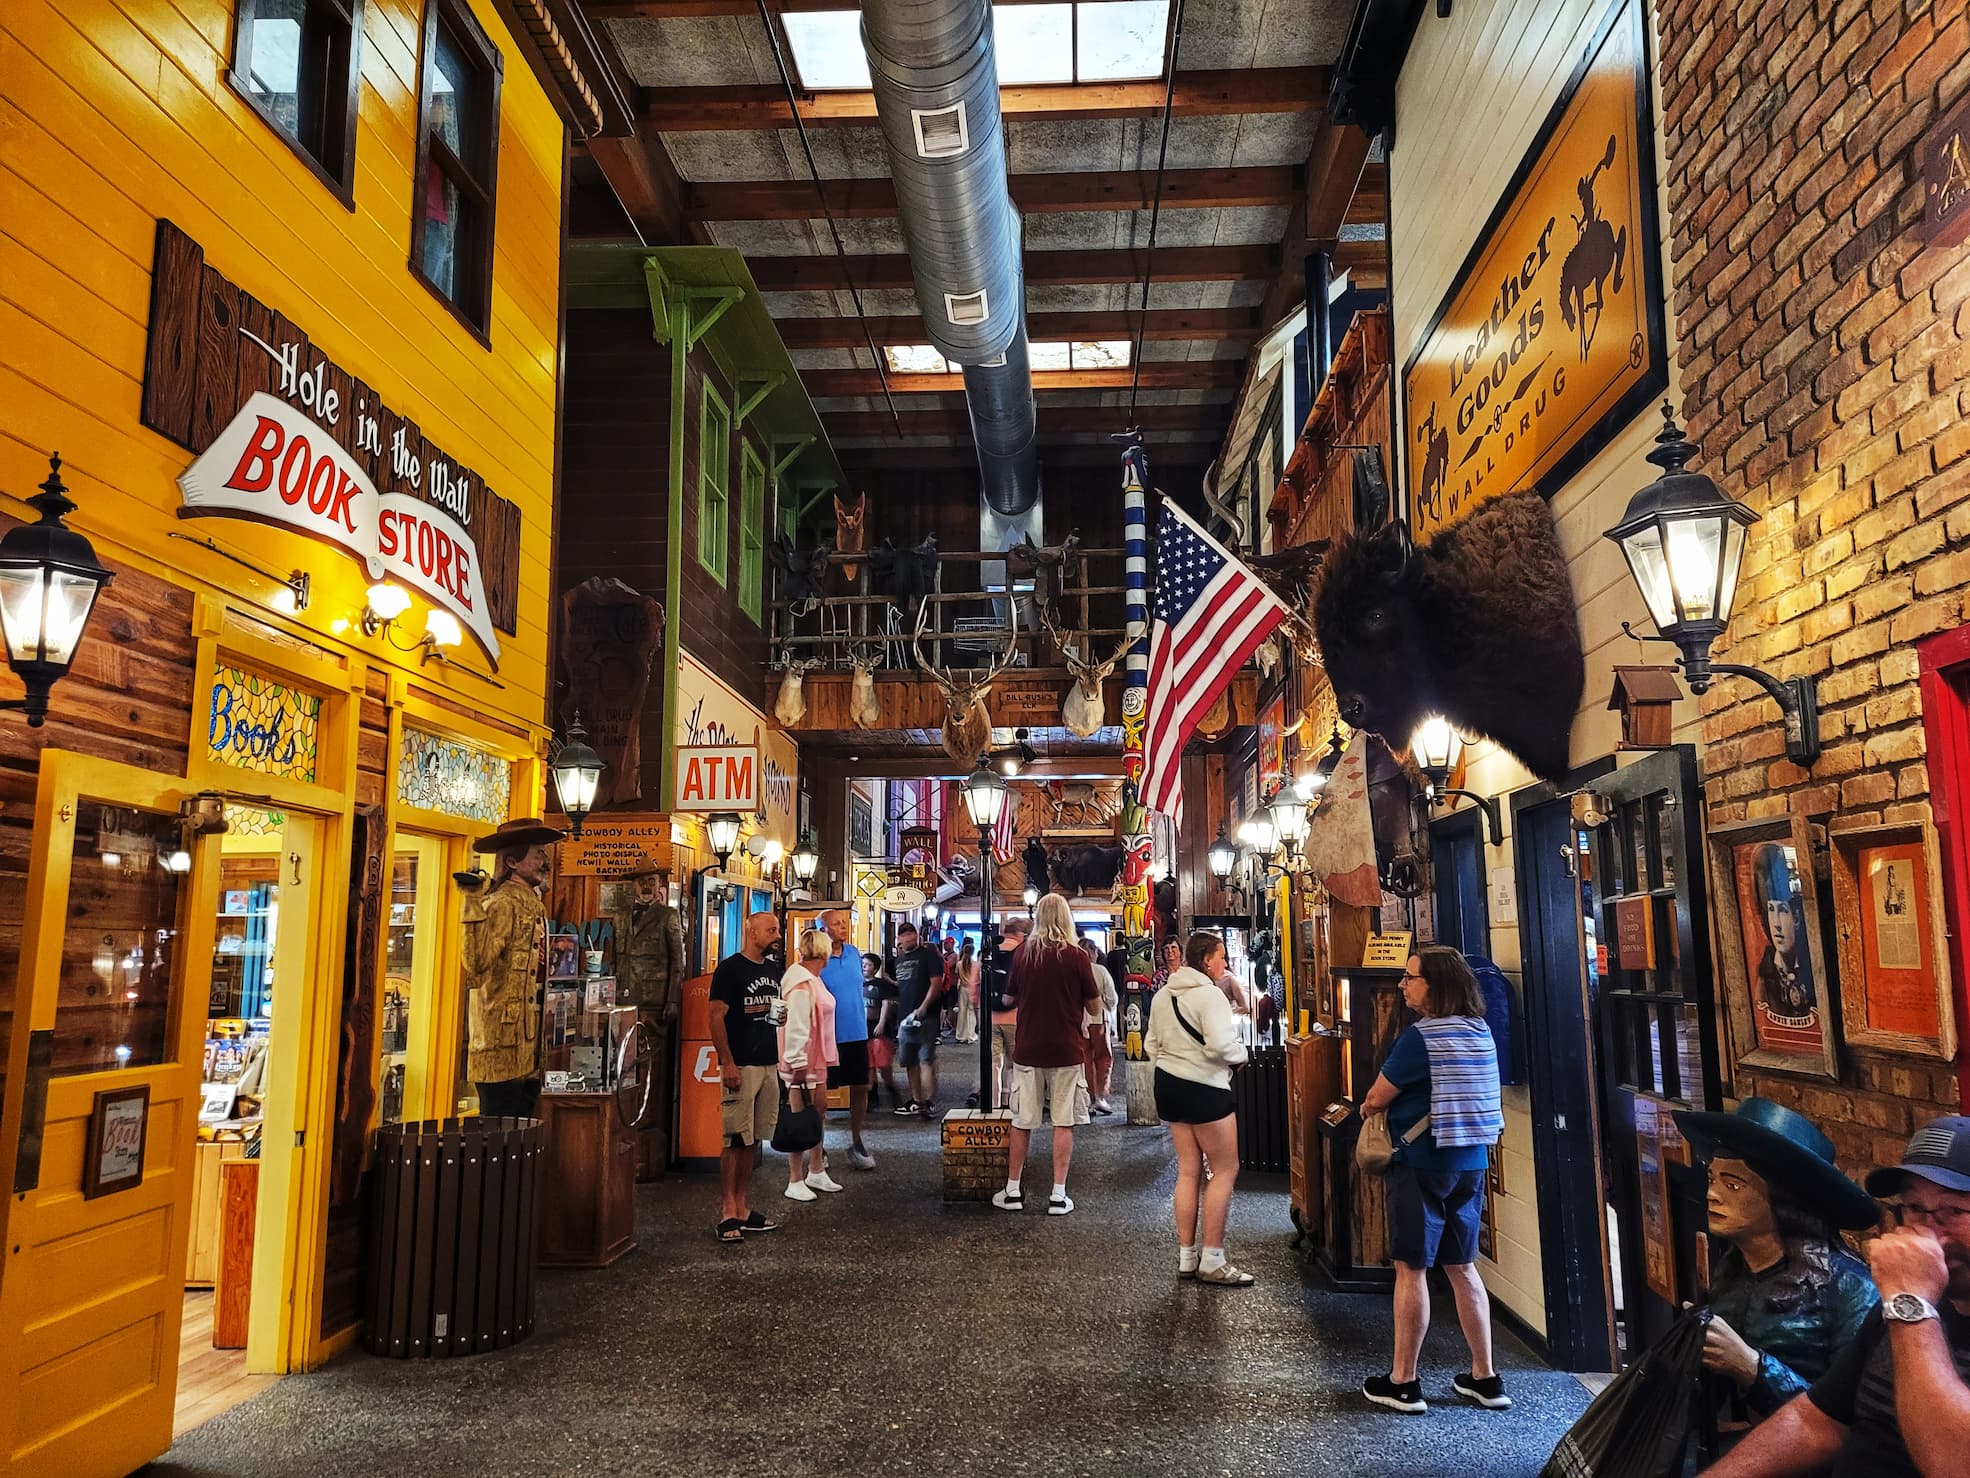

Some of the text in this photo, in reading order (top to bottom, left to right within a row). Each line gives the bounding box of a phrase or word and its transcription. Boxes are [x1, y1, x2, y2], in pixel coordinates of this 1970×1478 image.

[1449, 216, 1556, 398] Leather
[1457, 298, 1545, 435] Goods
[239, 327, 471, 526] Hole in the Wall
[1448, 366, 1567, 516] WALL DRUG
[222, 414, 364, 534] BOOK
[378, 508, 474, 613] STORE
[208, 683, 296, 765] Books
[682, 756, 753, 801] ATM
[594, 842, 642, 850] HISTORICAL
[607, 858, 631, 866] WALL
[628, 827, 661, 837] ALLEY
[904, 837, 934, 849] WALL
[958, 1125, 1009, 1136] COWBOY
[965, 1136, 1002, 1146] ALLEY
